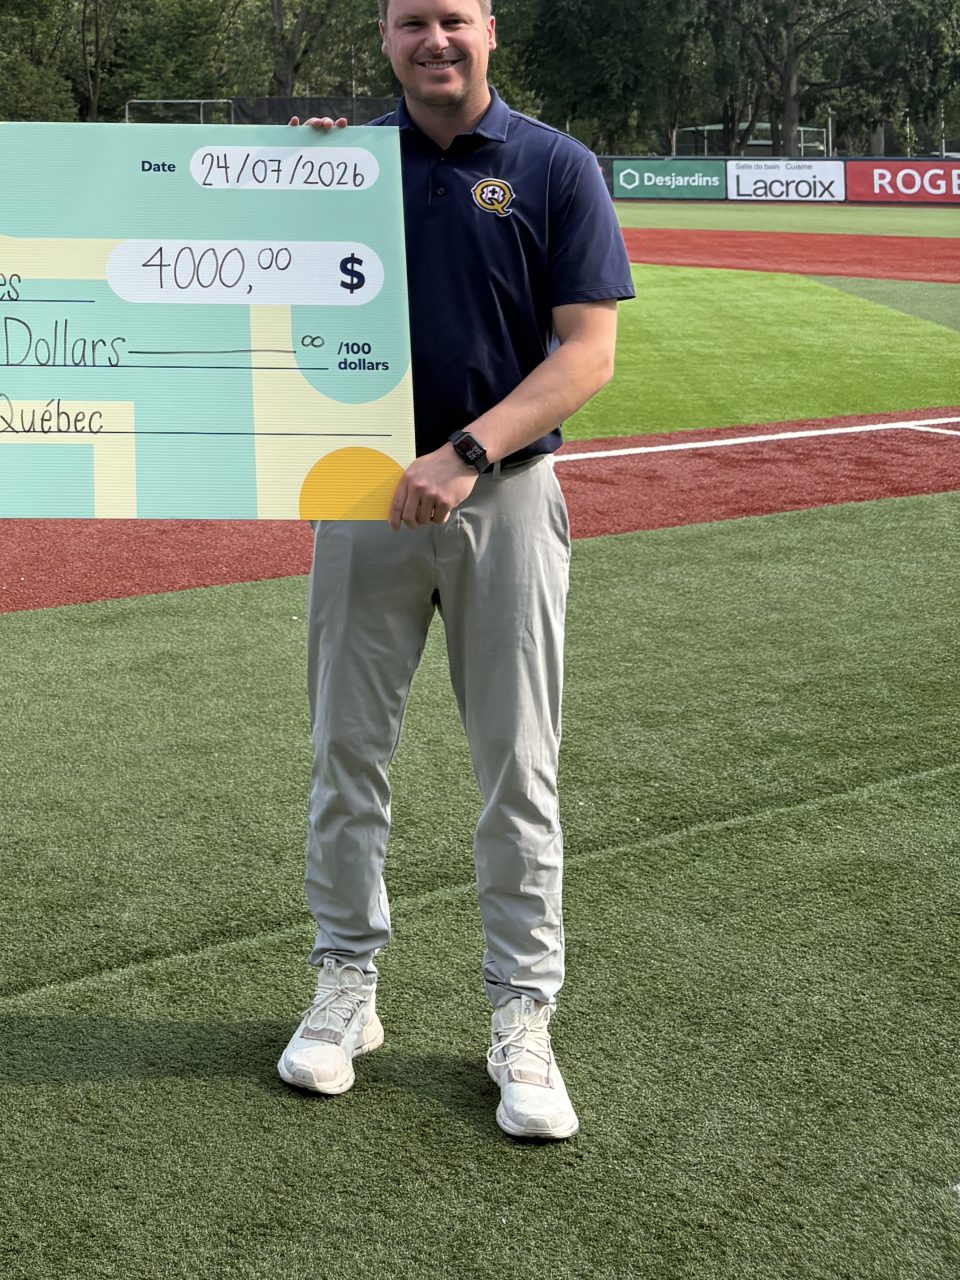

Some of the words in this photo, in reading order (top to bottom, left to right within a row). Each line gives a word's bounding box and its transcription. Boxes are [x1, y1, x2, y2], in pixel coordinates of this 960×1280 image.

[141, 160, 176, 172] Date
[201, 152, 365, 187] 24/07/2026
[644, 173, 720, 188] Desjardins
[736, 175, 835, 198] Lacroix
[339, 253, 366, 294] $
[4, 316, 126, 368] Dollars
[338, 342, 371, 356] /100
[338, 358, 389, 371] dollars
